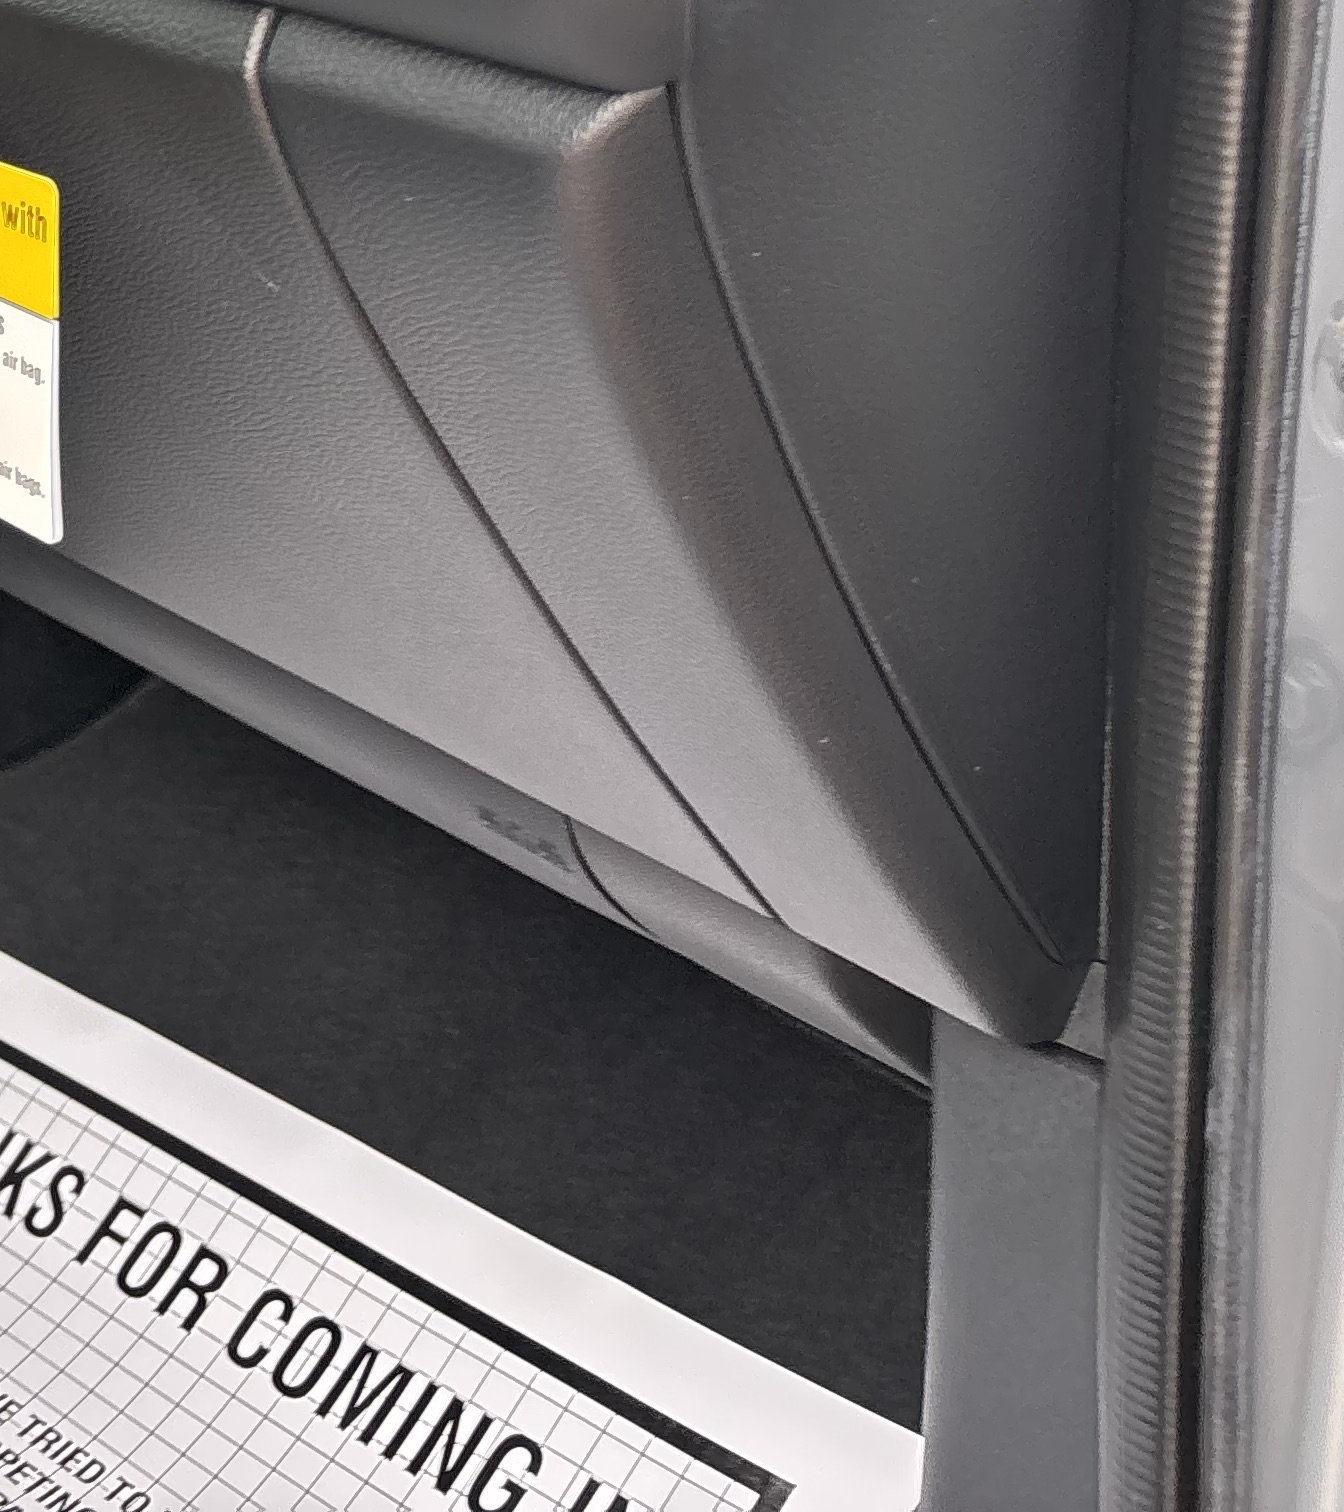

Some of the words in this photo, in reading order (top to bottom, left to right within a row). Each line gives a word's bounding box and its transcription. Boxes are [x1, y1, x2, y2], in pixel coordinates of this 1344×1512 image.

[1, 201, 48, 243] with
[74, 1197, 230, 1333] FOR
[226, 1287, 544, 1512] COMING
[16, 1413, 107, 1485] TRIED
[103, 1475, 152, 1512] TO
